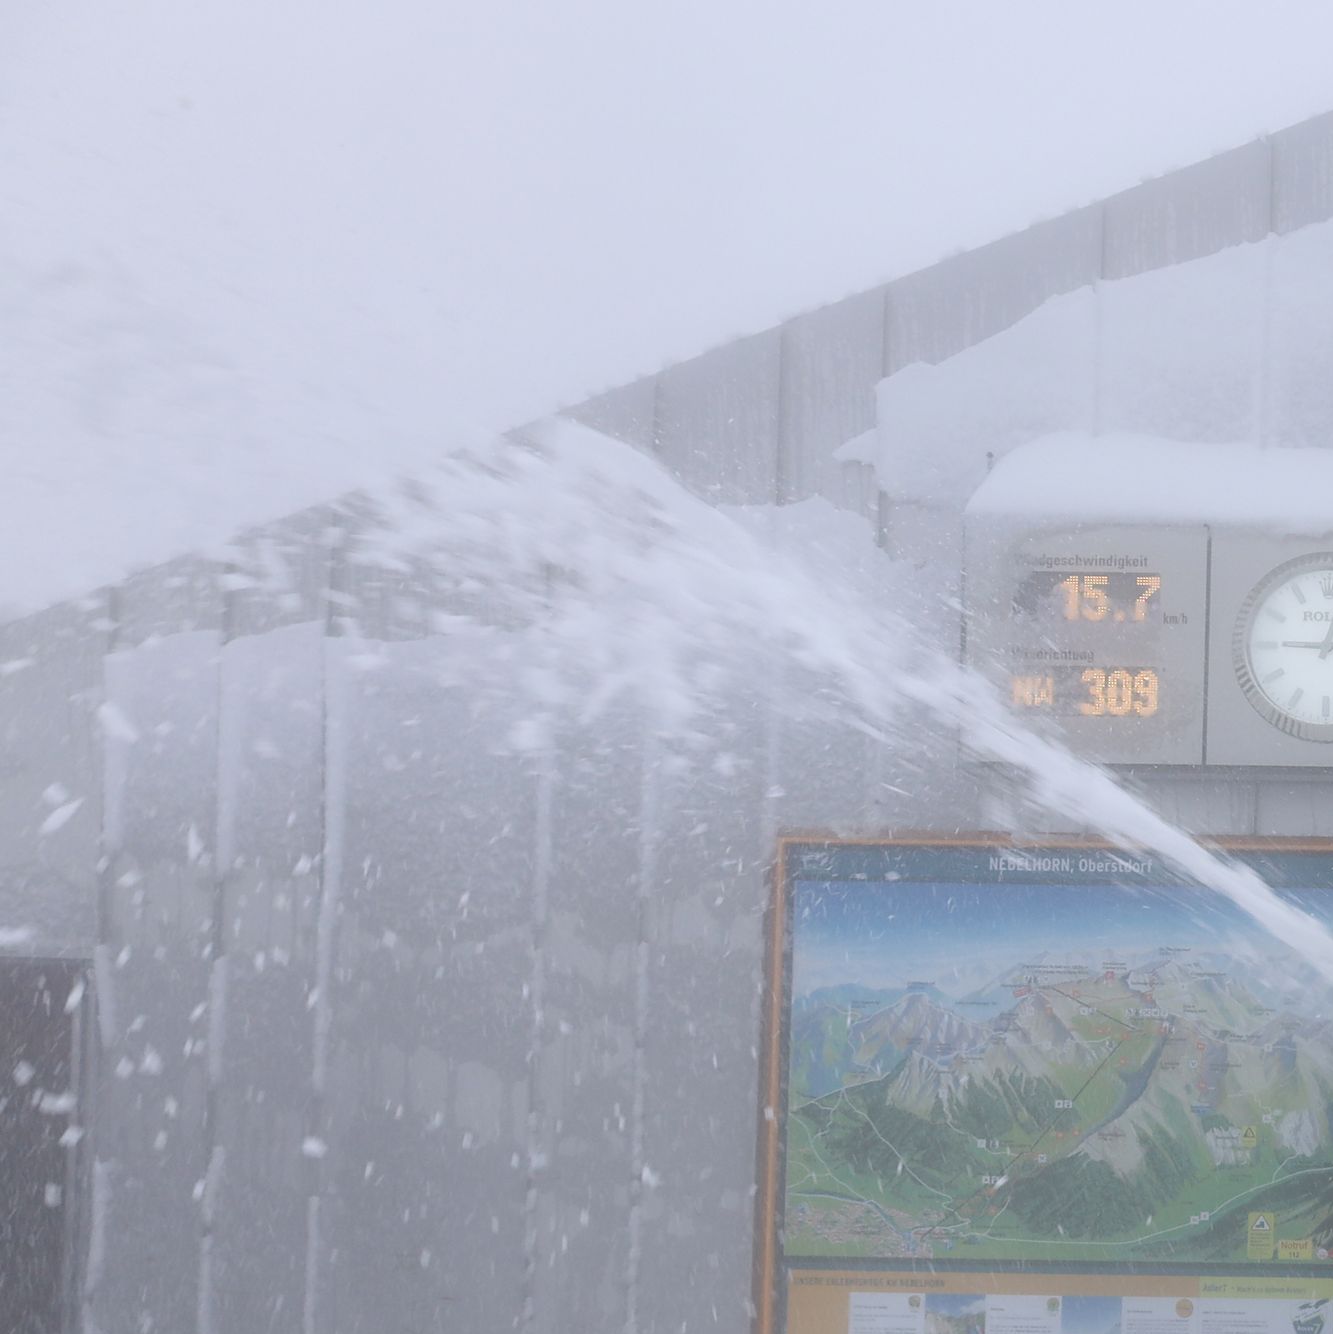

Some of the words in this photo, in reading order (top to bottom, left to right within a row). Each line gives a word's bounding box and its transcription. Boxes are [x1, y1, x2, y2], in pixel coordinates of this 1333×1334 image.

[1012, 554, 1148, 569] dgeschwindigkeit
[1061, 575, 1161, 623] 15.7
[1163, 612, 1188, 625] km/h
[1080, 669, 1160, 716] 309
[989, 857, 1075, 873] NEBELHORN,
[1079, 857, 1153, 873] Oberstdorf
[1280, 1241, 1308, 1250] Notruf
